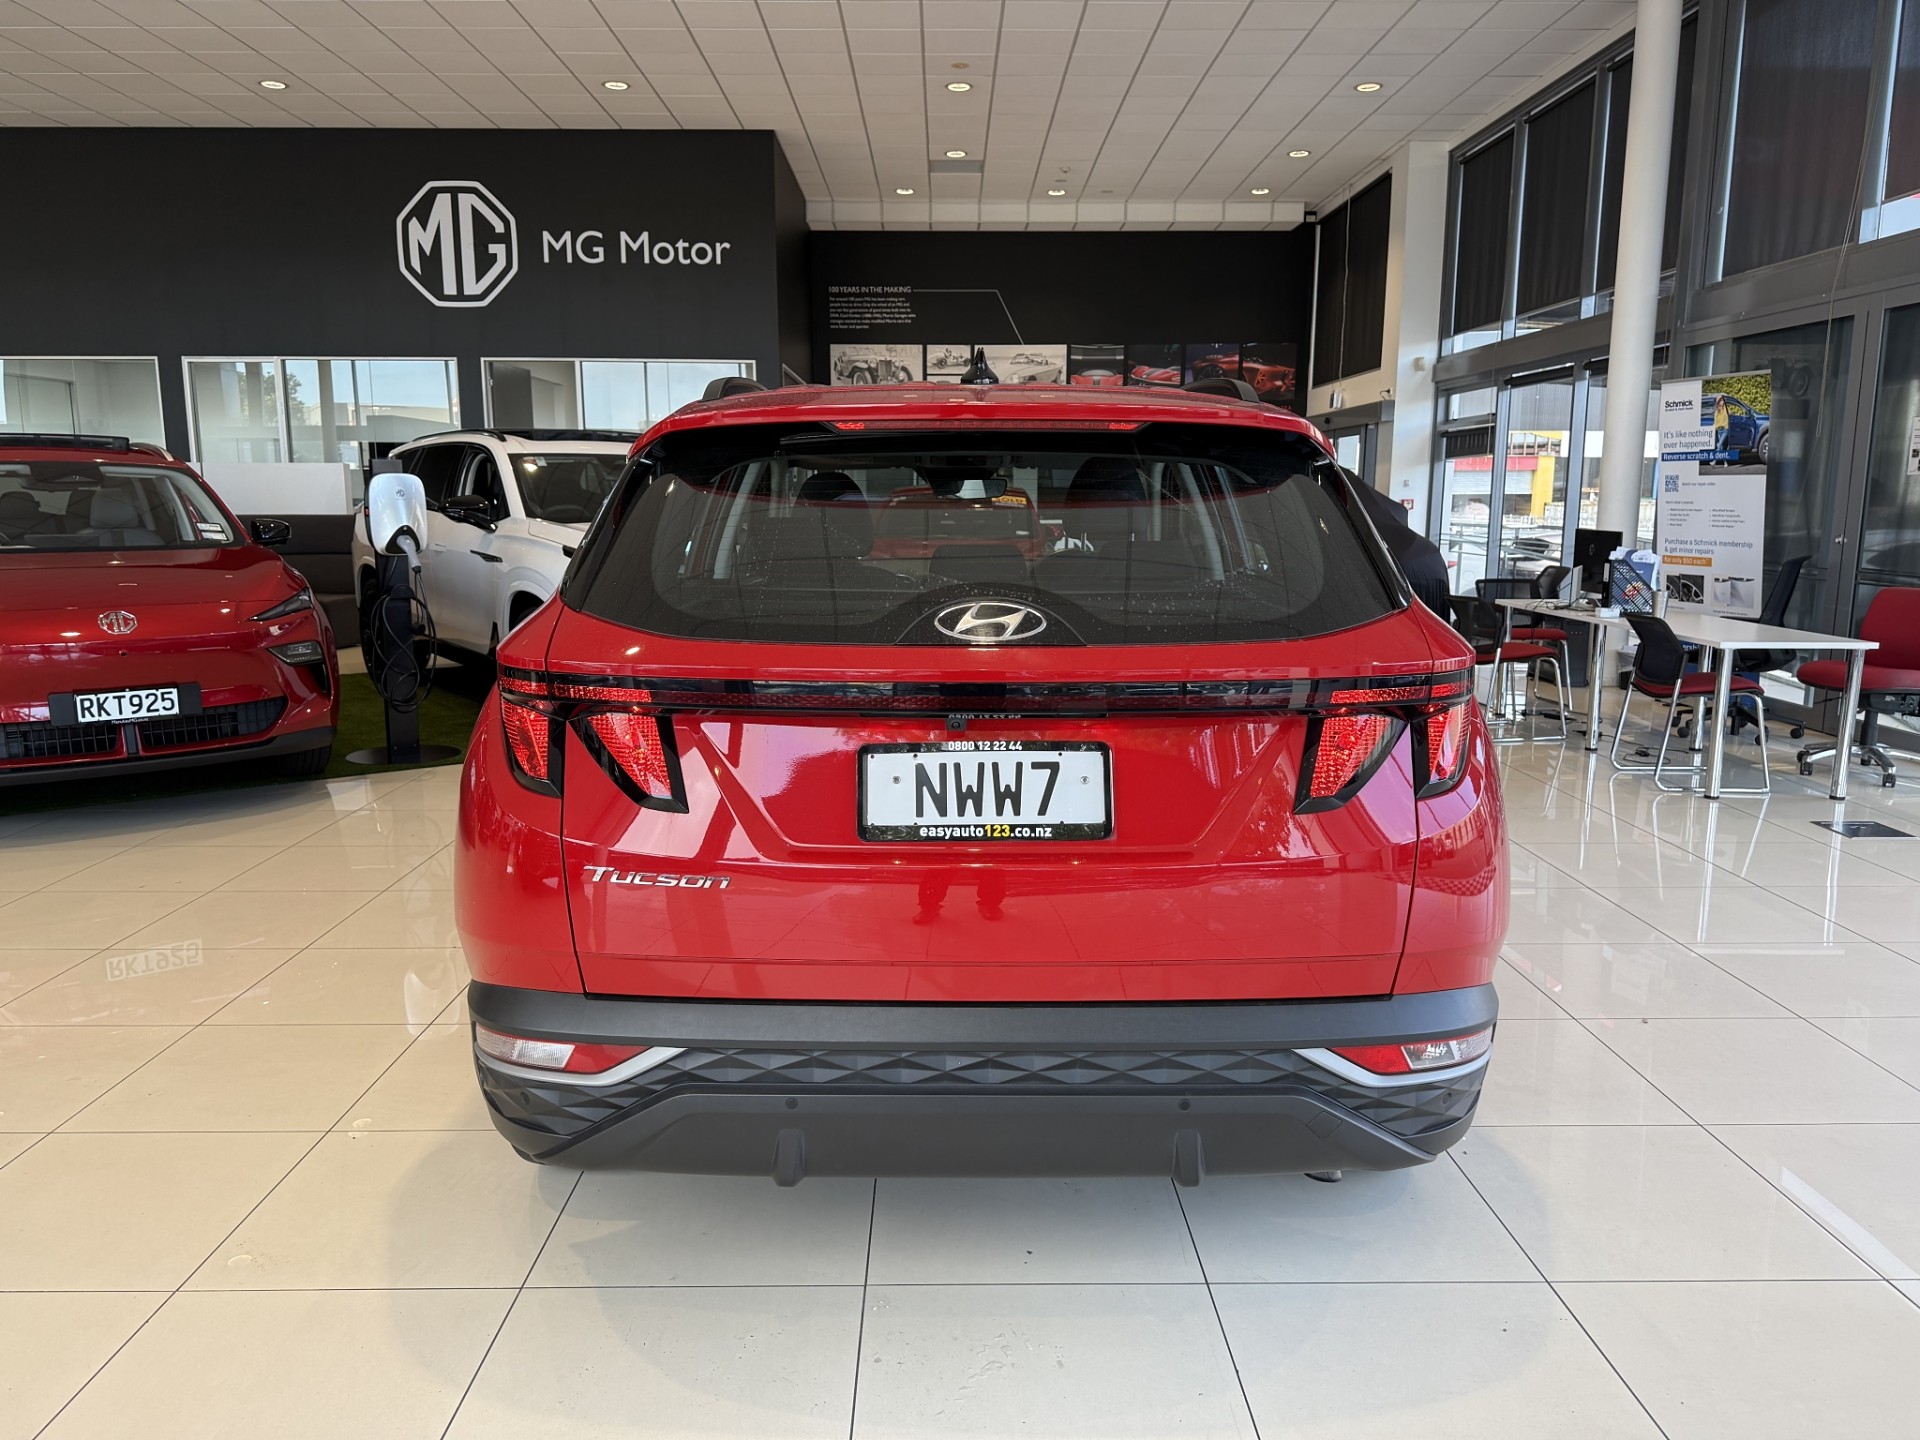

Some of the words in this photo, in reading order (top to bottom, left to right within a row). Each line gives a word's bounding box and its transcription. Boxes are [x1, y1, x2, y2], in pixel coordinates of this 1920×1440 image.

[407, 192, 507, 296] MG
[542, 230, 605, 264] MG
[619, 230, 731, 265] Motor
[1664, 399, 1694, 408] Schmick
[1663, 430, 1674, 439] It's
[1675, 429, 1687, 438] like
[1688, 428, 1713, 439] nothing
[1679, 439, 1713, 450] happened.
[1663, 453, 1686, 461] Reverse
[1686, 452, 1708, 460] scratch
[1715, 451, 1731, 459] dent.
[1664, 538, 1689, 546] Purchase
[1693, 539, 1717, 547] Schmick
[1718, 540, 1753, 549] membership
[1669, 546, 1678, 554] get
[1694, 547, 1715, 555] repairs
[80, 690, 176, 719] RKT925
[948, 741, 975, 751] 0800
[977, 741, 990, 751] 12
[991, 741, 1006, 751] 22
[1008, 741, 1023, 751] 44
[915, 761, 1060, 817] NWW7
[919, 824, 1052, 840] easyauto123.co.nz
[583, 865, 731, 889] Tucson
